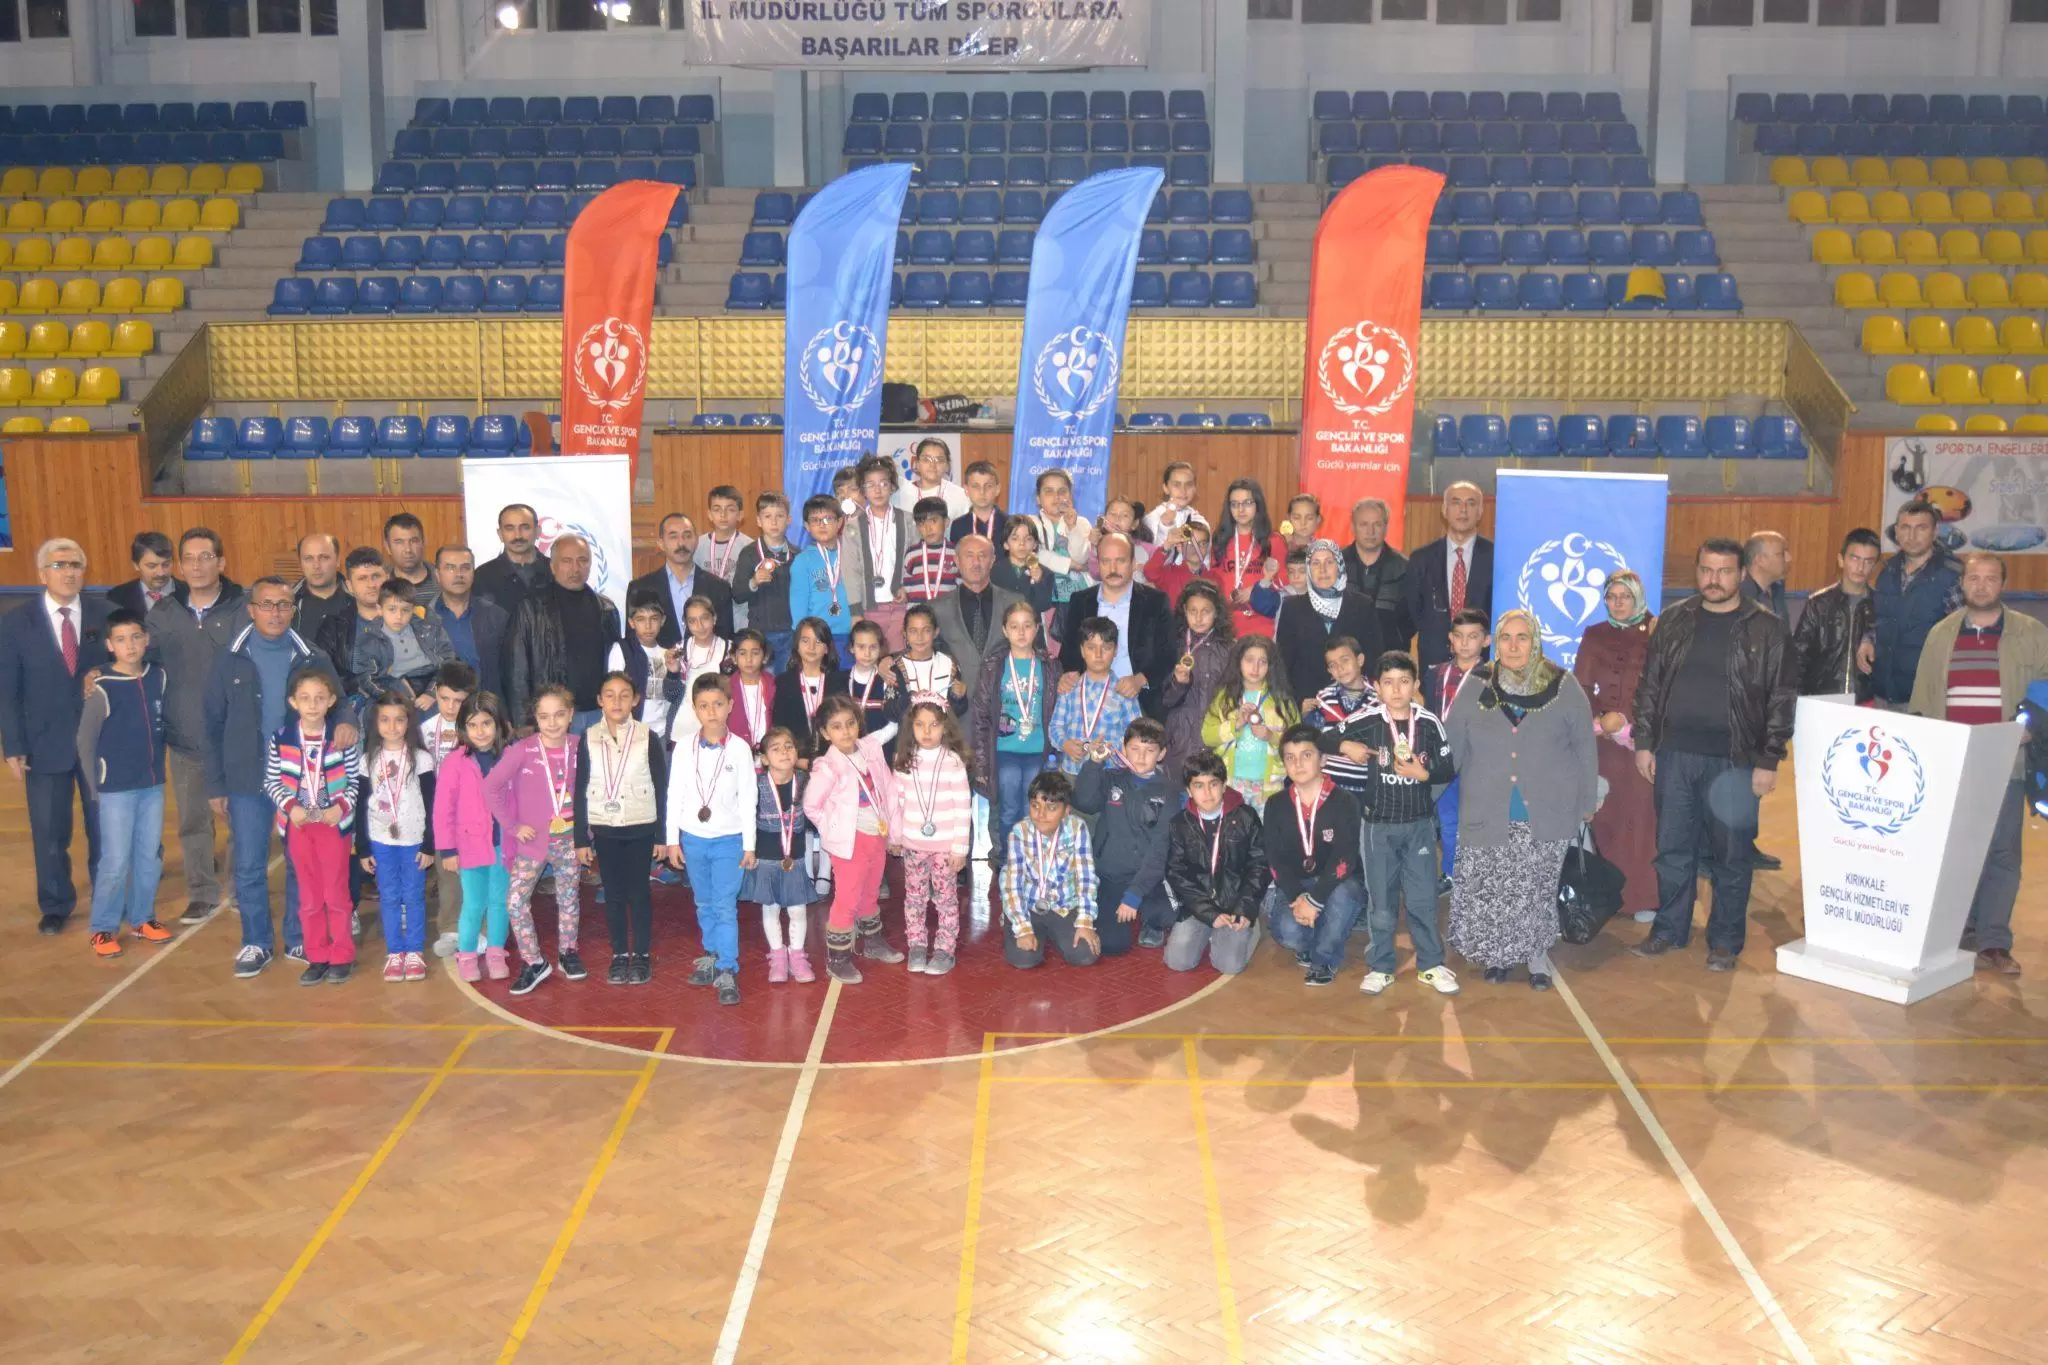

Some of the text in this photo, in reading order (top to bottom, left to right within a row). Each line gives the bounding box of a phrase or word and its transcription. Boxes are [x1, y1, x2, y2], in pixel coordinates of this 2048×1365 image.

[801, 37, 939, 61] BAŞARILAR
[607, 425, 619, 435] VE
[620, 427, 637, 437] SPOR
[1352, 419, 1370, 430] T.C.
[851, 428, 875, 439] SPOR
[1315, 430, 1404, 444] GENÇLİK VE SPOR
[1070, 436, 1081, 446] VE
[1082, 435, 1107, 447] SPOR
[1331, 443, 1388, 455] BAKANLIĞI
[1848, 800, 1892, 816] BAKANLIĞI
[1873, 796, 1883, 804] VE
[1884, 799, 1905, 809] SPOR
[1820, 884, 1909, 916] GENÇLİK HİZMETLERİ VE
[1824, 904, 1845, 919] SPOR
[1854, 910, 1903, 933] MÜDÜRLÜĞÜ
